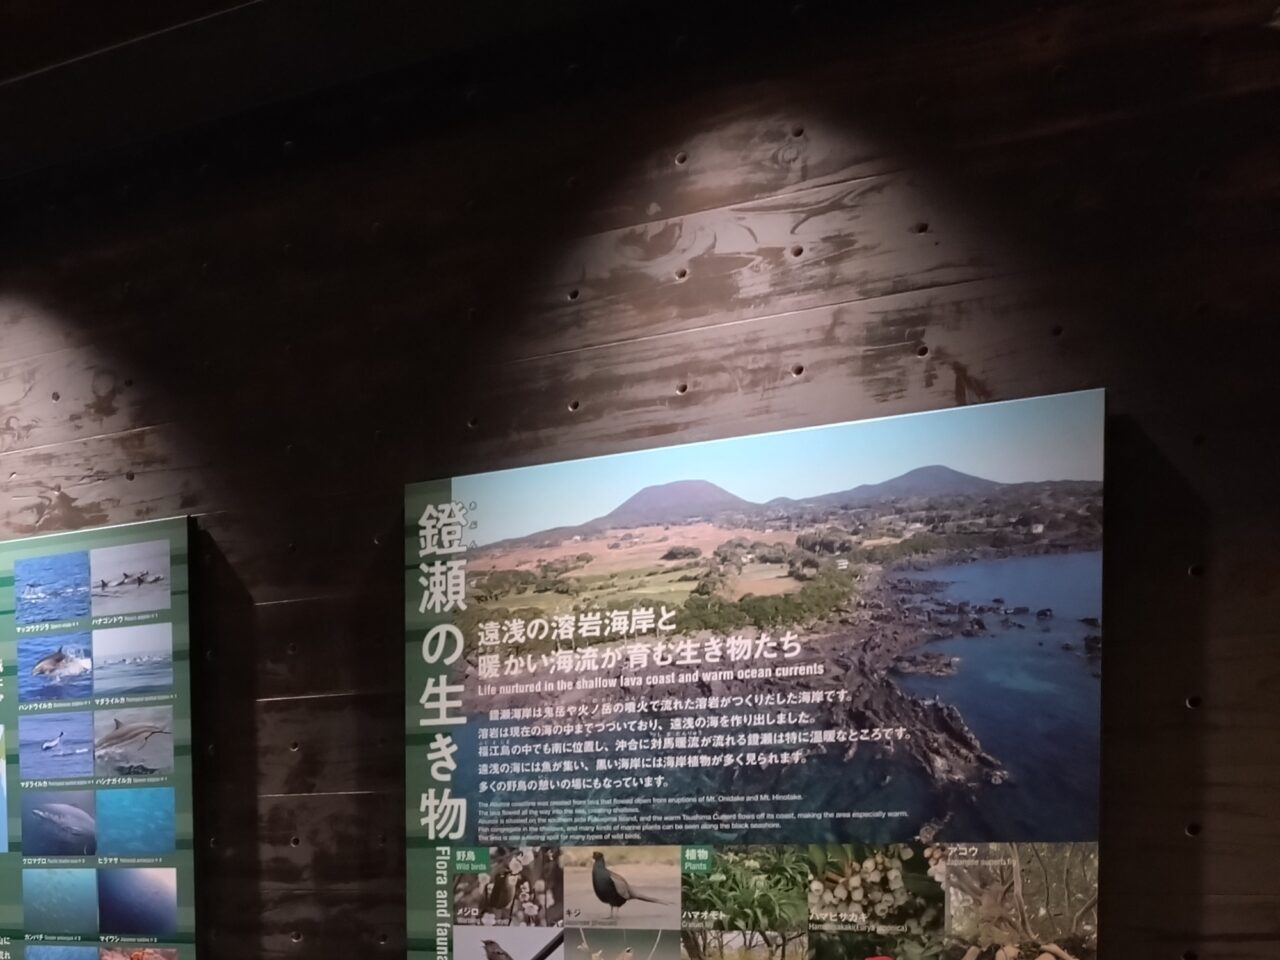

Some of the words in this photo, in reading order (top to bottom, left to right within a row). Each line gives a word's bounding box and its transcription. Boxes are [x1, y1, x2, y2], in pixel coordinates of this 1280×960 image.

[478, 606, 676, 646] 遠浅の溶岩海岸と
[478, 632, 802, 680] 暖かい海流が育む生き物たち
[418, 500, 467, 842] 鐙瀬の生き物
[478, 684, 496, 697] Life
[500, 681, 541, 695] nurtured
[544, 681, 554, 692] in
[557, 680, 572, 691] the
[576, 677, 617, 690] shallow
[620, 675, 642, 687] lava
[646, 673, 675, 685] coast
[679, 670, 699, 684] and
[702, 669, 734, 682] warm
[737, 667, 771, 680] ocean
[775, 663, 824, 678] currents
[456, 851, 476, 862] 野鳥
[685, 849, 709, 860] 植物
[947, 847, 978, 856] アコウ
[436, 846, 450, 885] Flora
[685, 861, 707, 871] Plants
[436, 890, 450, 918] and
[457, 908, 478, 916] メジロ
[682, 911, 726, 920] ハマオモト
[809, 912, 868, 923] ハマヒサカキ
